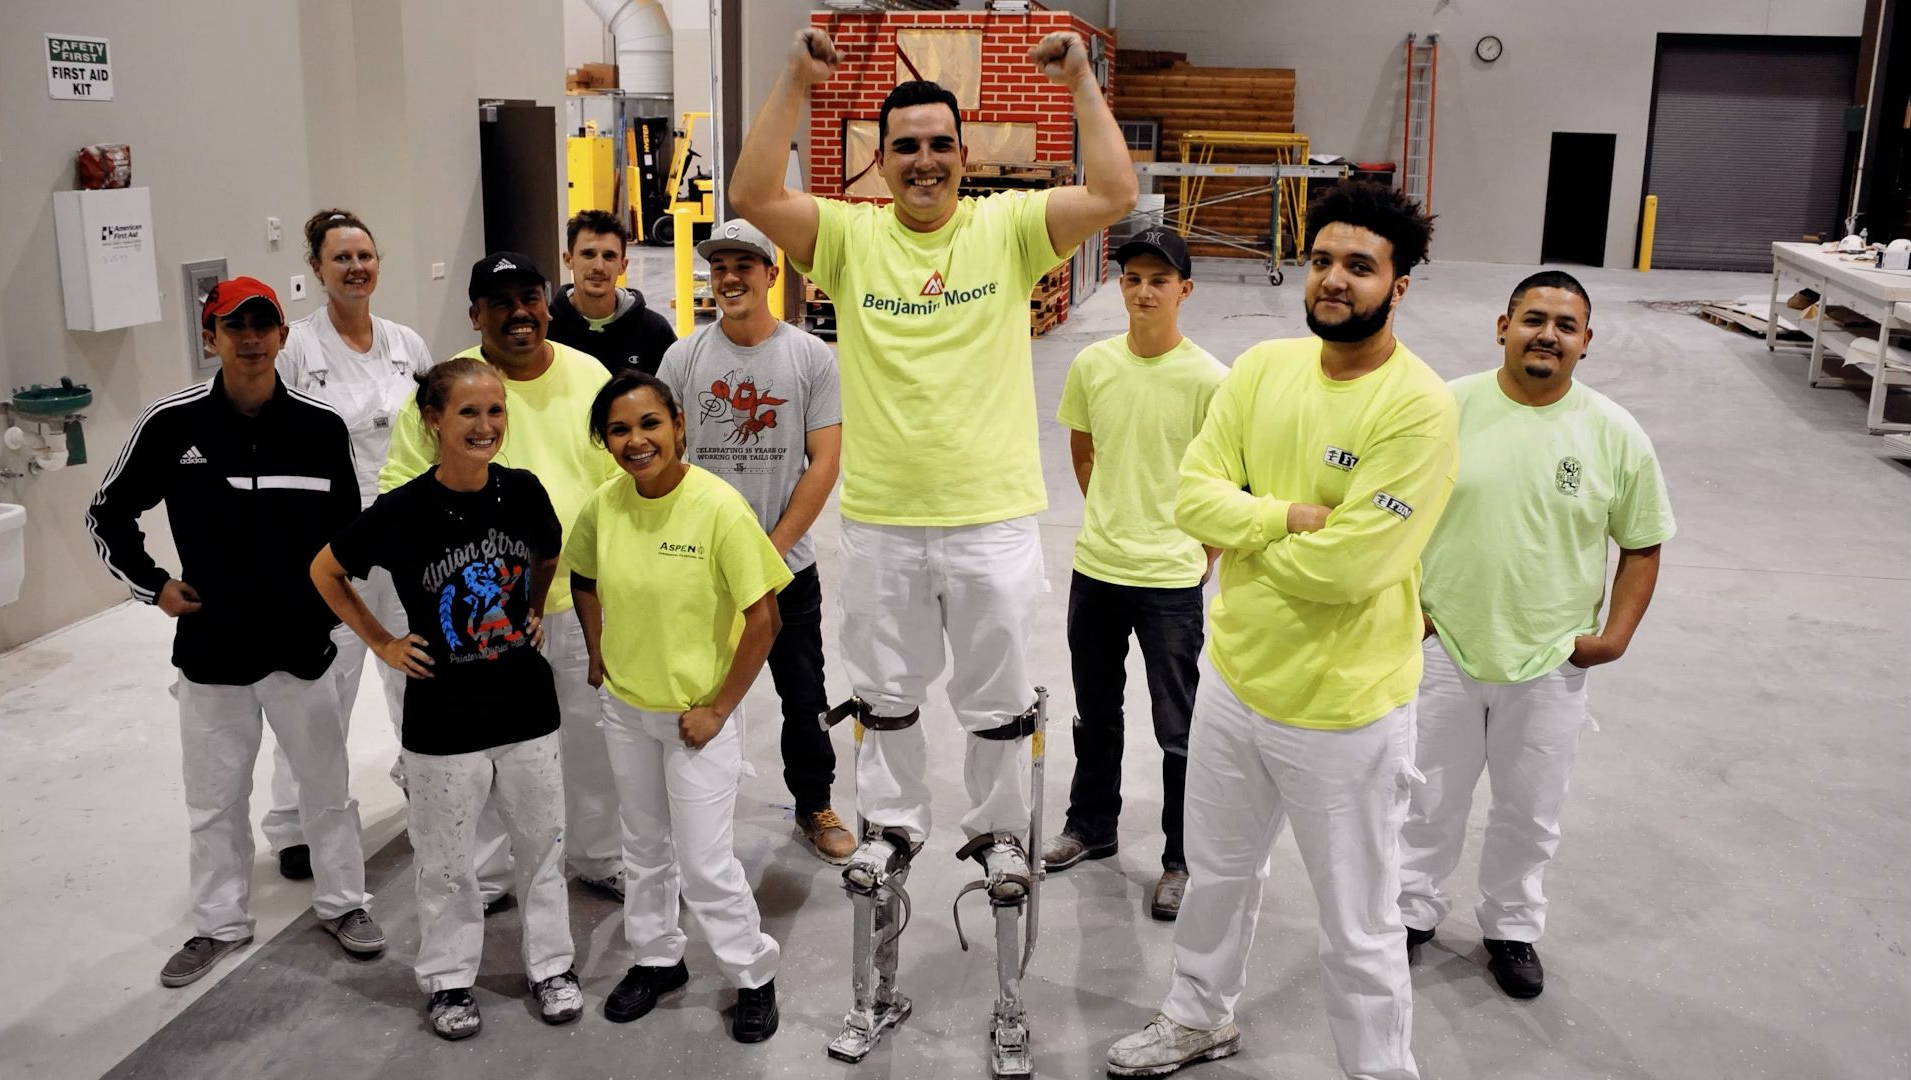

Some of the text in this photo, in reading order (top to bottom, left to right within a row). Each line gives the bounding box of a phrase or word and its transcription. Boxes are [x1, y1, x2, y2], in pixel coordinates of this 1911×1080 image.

[51, 40, 104, 56] SAFETY
[62, 51, 98, 62] FIRST
[52, 67, 108, 81] FIRST AID
[73, 83, 91, 95] KIT
[724, 224, 740, 239] C
[492, 264, 517, 272] adidas
[943, 281, 996, 306] Moore
[180, 456, 207, 464] adidas
[422, 527, 531, 593] Union Stron
